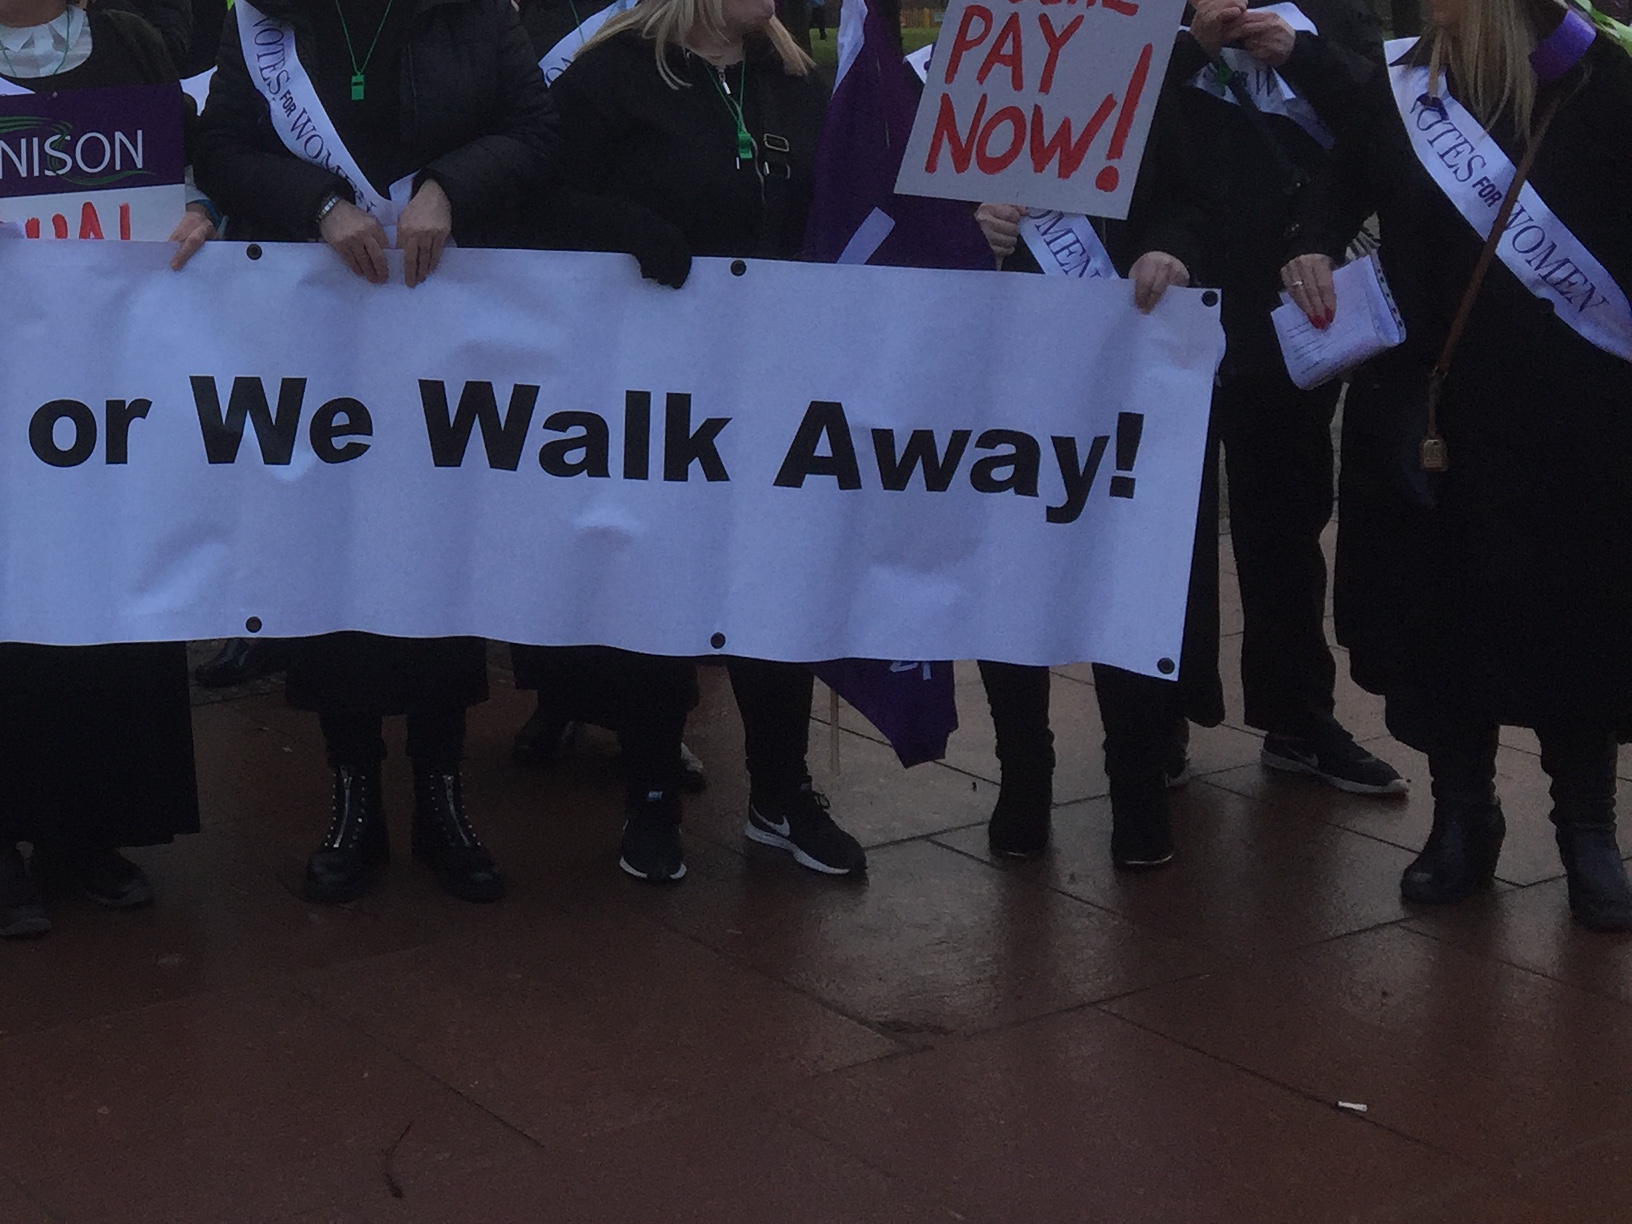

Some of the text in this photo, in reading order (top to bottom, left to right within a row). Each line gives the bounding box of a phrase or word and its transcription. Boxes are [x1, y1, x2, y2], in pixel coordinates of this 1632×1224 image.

[945, 4, 1085, 95] PAY
[279, 90, 297, 118] FOR
[924, 42, 1154, 193] NOW!
[1471, 175, 1503, 209] FOR
[27, 396, 153, 468] or
[189, 374, 374, 467] We
[418, 378, 733, 484] Walk
[772, 399, 1144, 526] Away!
